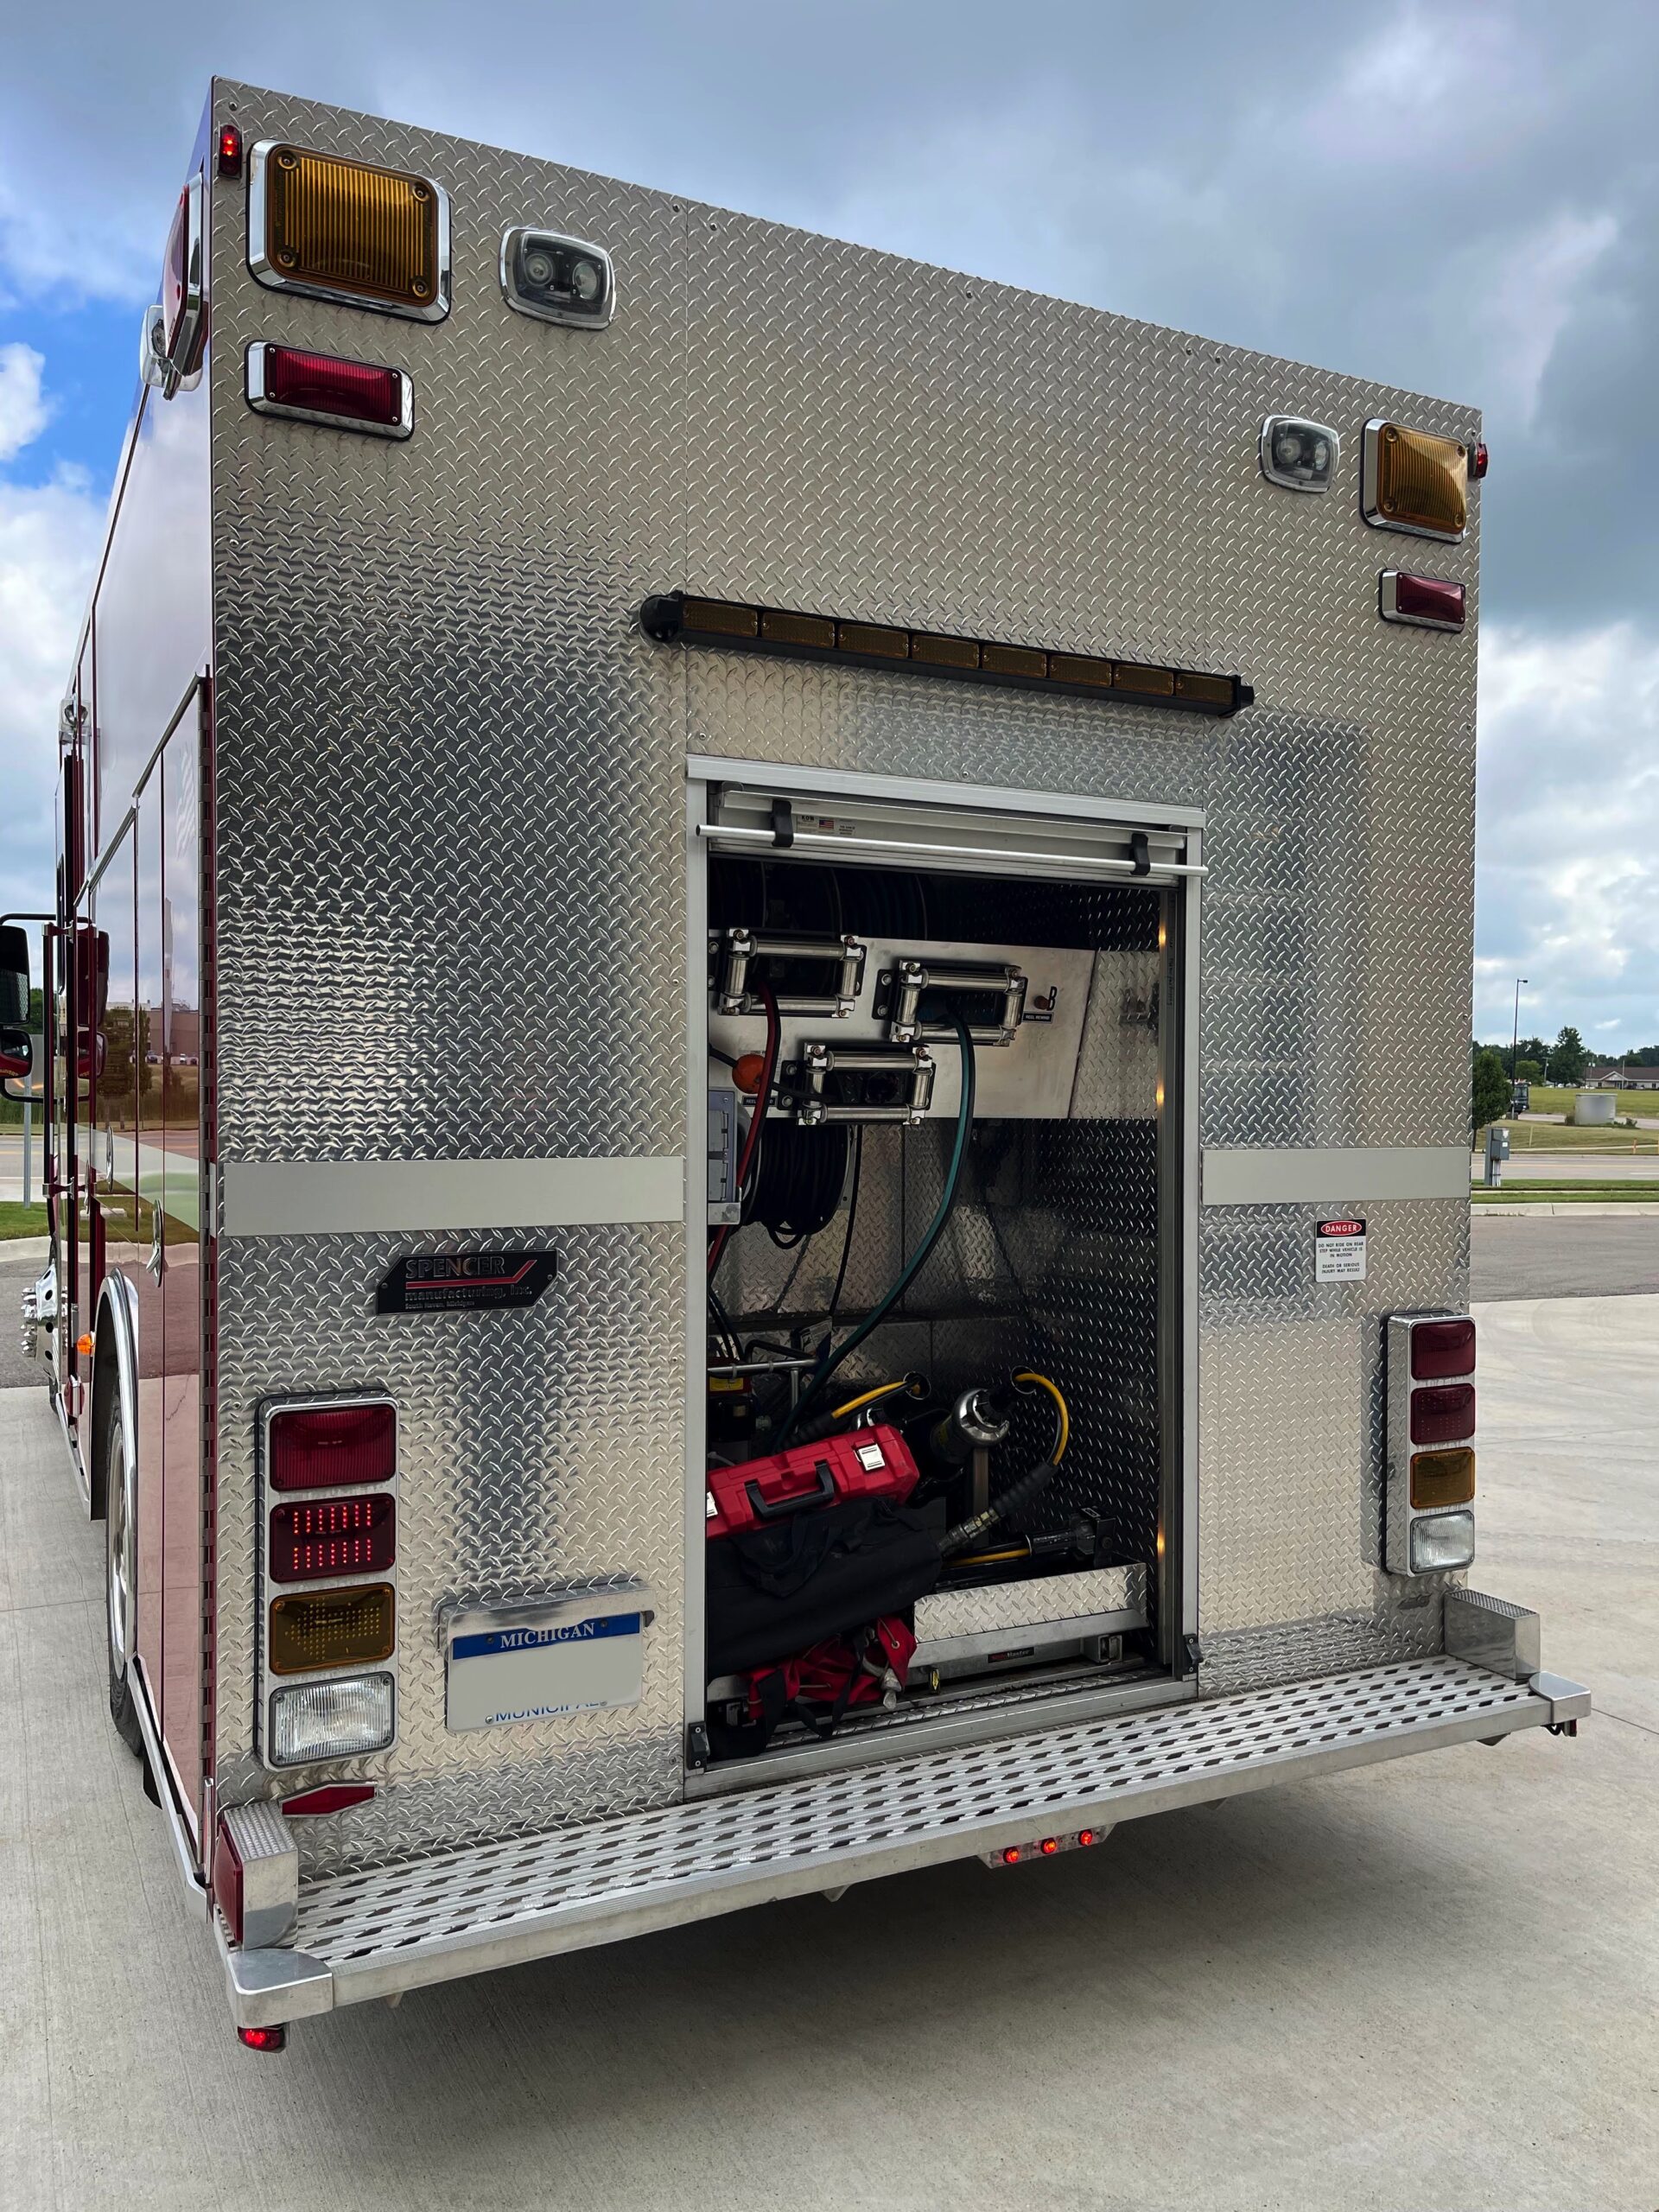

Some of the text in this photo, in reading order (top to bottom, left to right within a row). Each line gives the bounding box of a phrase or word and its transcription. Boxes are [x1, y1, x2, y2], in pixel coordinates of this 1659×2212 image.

[404, 1256, 505, 1279] SPENCER
[404, 1284, 532, 1301] manufacturing, Inc.
[500, 1623, 594, 1649] MICHIGAN
